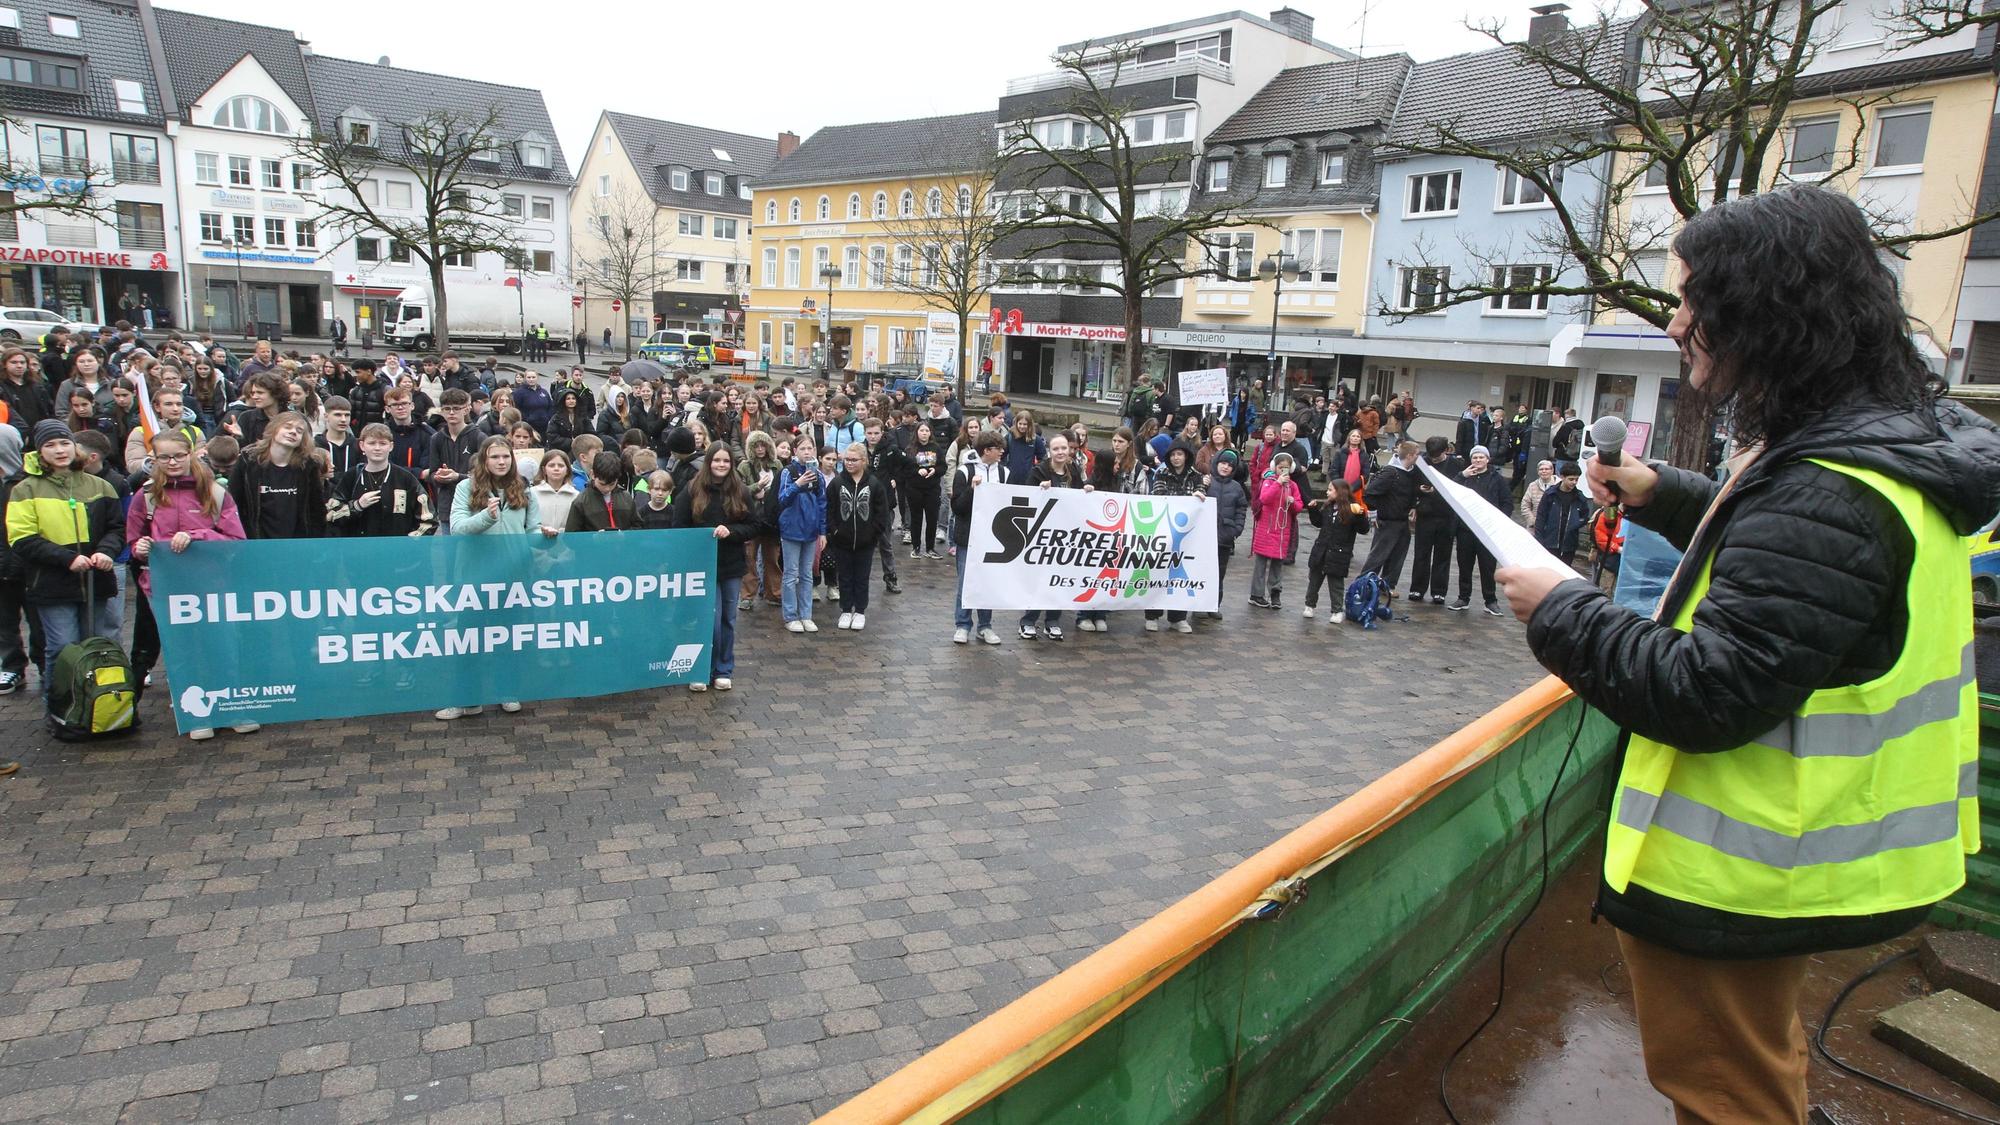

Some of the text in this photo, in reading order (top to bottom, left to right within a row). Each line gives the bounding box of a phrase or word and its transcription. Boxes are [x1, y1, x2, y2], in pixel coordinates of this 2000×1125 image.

[1036, 325, 1126, 342] Markt-Apothe
[1186, 332, 1226, 344] pequeno
[168, 571, 707, 625] BILDUNGSKATASTROPHE
[317, 619, 603, 664] BEKÄMPFEN.
[233, 684, 297, 698] LSV NRW
